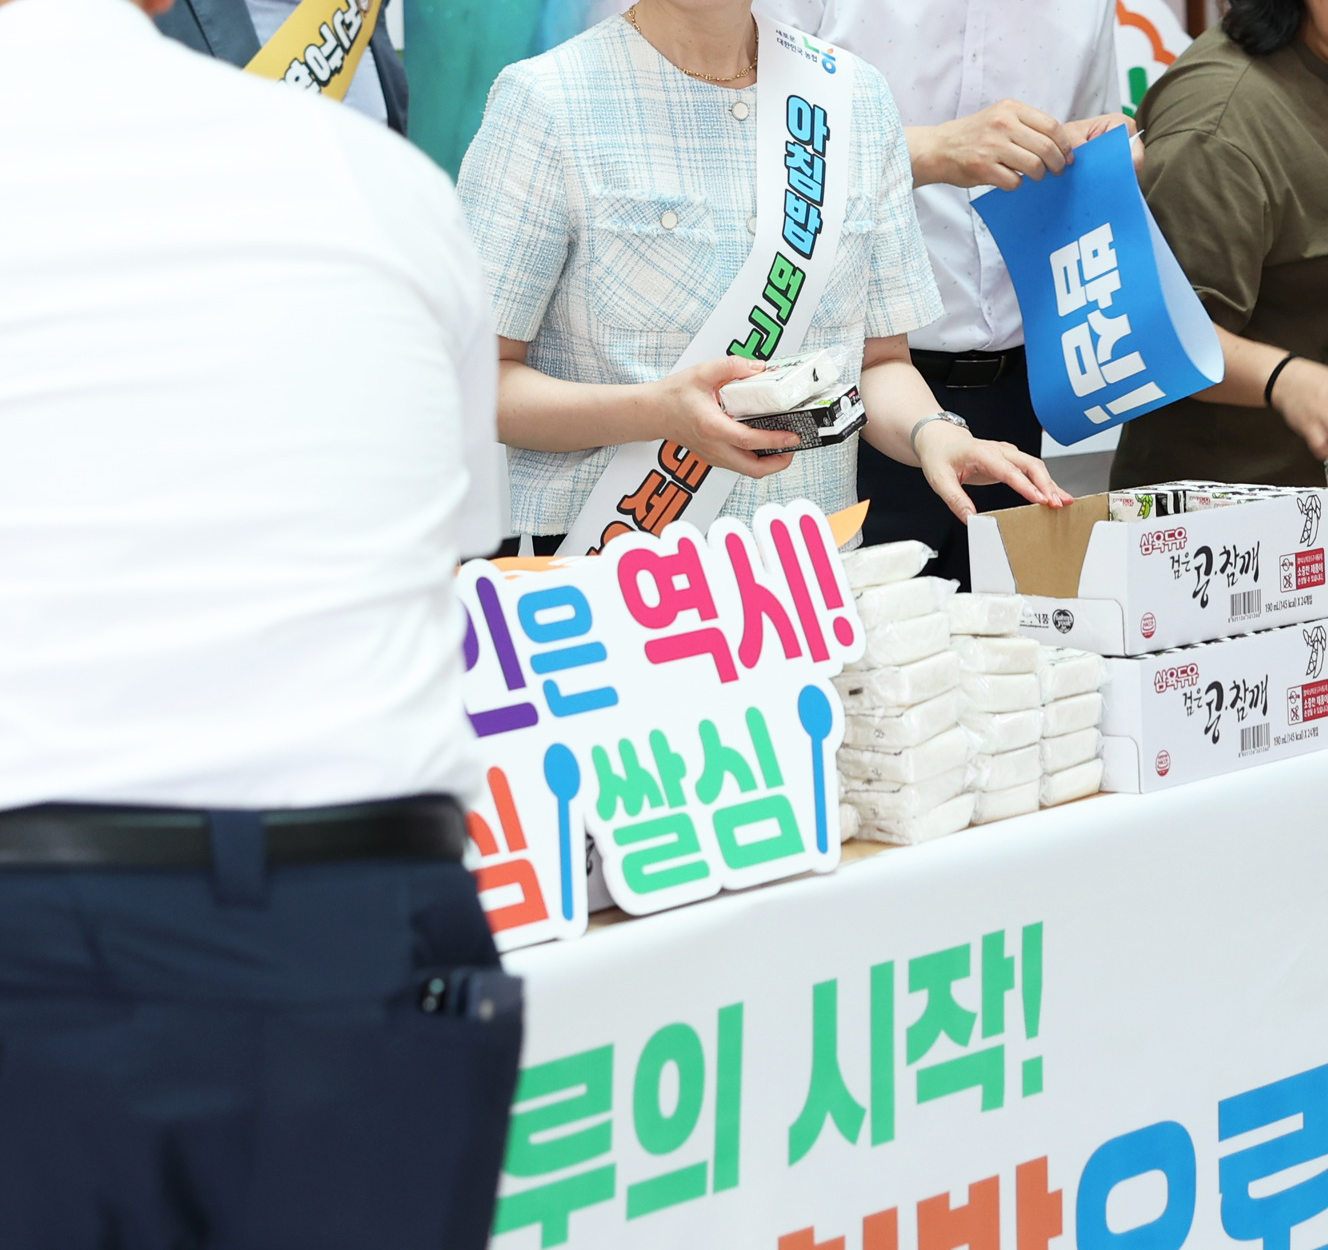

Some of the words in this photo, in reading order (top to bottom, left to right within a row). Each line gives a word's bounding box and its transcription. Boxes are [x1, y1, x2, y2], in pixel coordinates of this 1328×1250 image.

[781, 94, 832, 259] 아침밥
[1049, 222, 1167, 426] 밥심!
[617, 513, 855, 684] 역시!
[1140, 527, 1187, 556] 삼육두유
[1170, 552, 1191, 580] 검은
[1154, 663, 1199, 693] 삼육두유
[1182, 688, 1203, 717] 검은
[591, 707, 805, 895] 쌀심
[788, 921, 1044, 1167] 시작!
